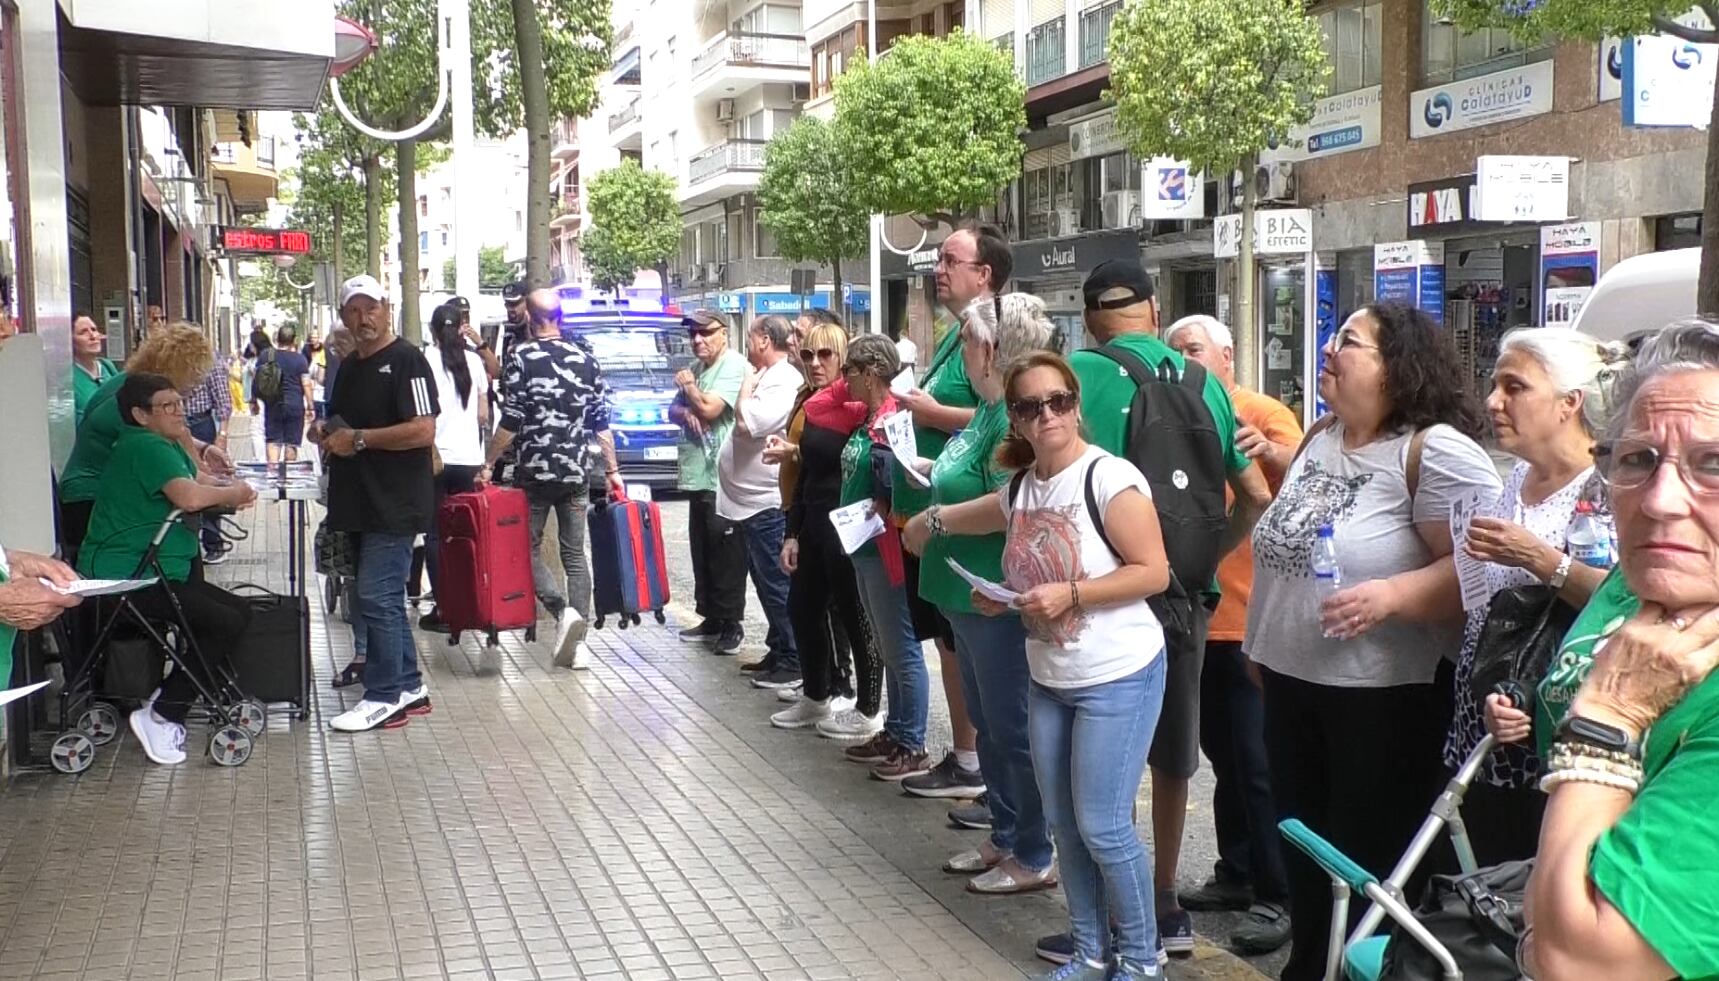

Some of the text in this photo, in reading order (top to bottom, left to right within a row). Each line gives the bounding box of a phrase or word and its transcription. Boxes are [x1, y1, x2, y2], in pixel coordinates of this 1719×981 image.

[1410, 187, 1463, 227] HAYA
[1266, 216, 1307, 235] BIA
[1266, 236, 1307, 247] ESTETIC
[1052, 246, 1076, 265] Aural
